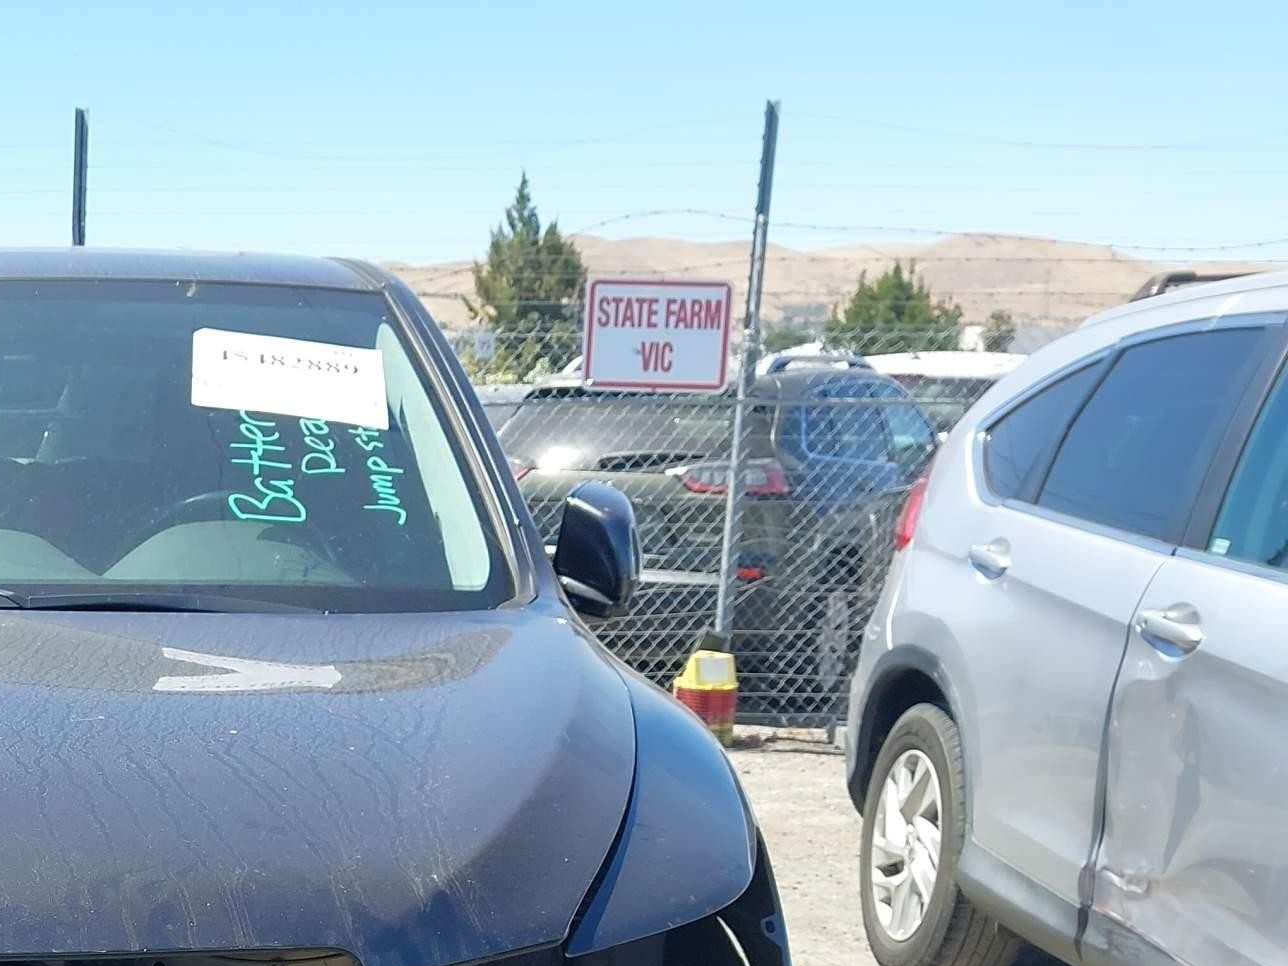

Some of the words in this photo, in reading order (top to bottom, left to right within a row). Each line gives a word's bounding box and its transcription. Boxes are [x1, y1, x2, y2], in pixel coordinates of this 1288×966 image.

[598, 297, 659, 328] STATE
[665, 298, 722, 330] FARM
[641, 341, 674, 372] VIC
[299, 418, 346, 474] Dea
[348, 426, 384, 451] st
[228, 409, 306, 522] Batter
